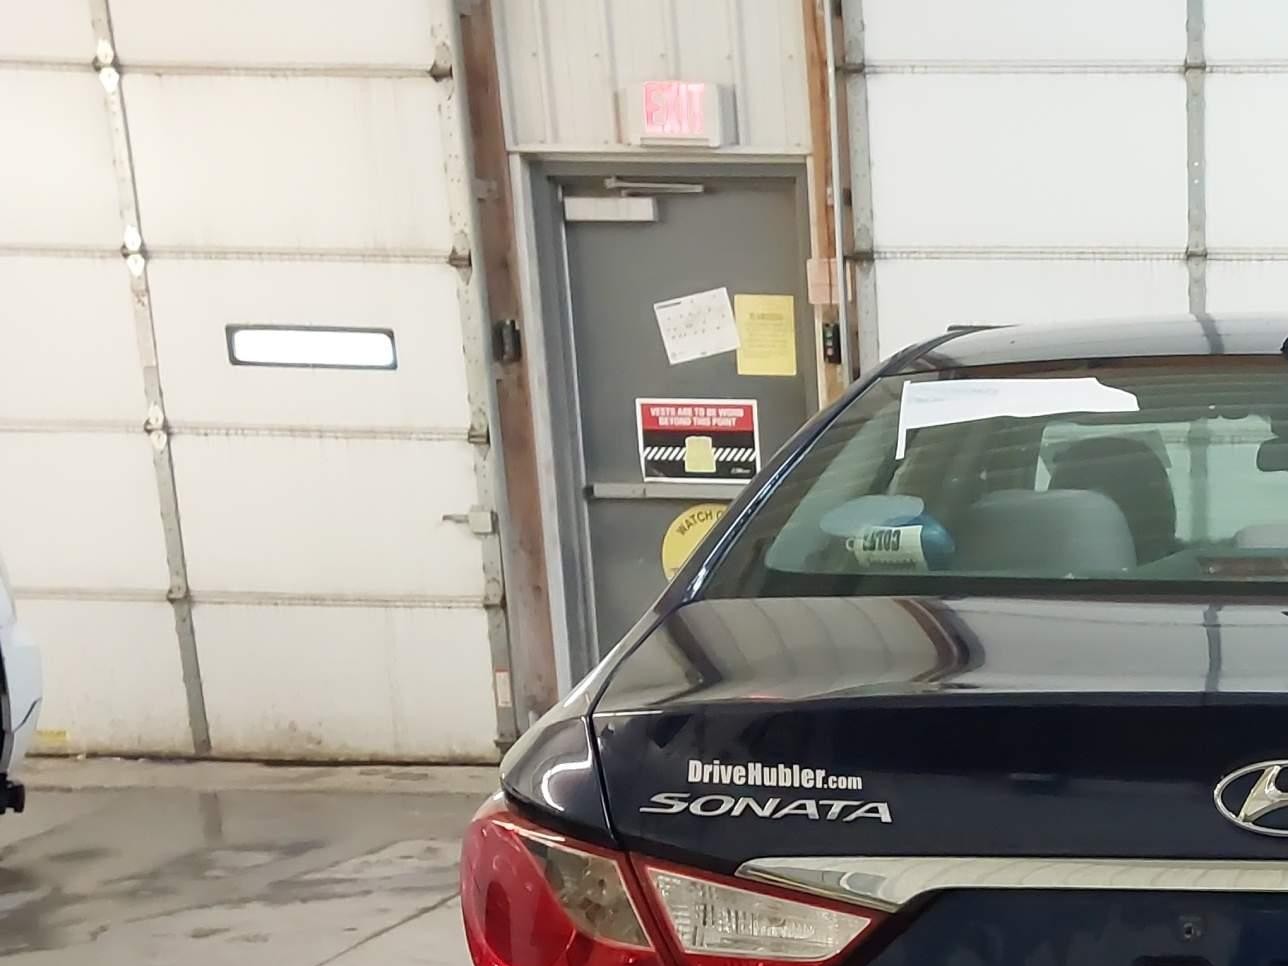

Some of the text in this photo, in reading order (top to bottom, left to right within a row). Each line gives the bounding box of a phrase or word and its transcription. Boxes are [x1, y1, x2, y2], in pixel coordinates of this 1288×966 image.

[645, 82, 705, 134] EXIT
[650, 407, 676, 417] VESTS
[677, 407, 693, 417] ARE
[694, 408, 705, 417] TO
[706, 408, 717, 417] BE
[658, 416, 737, 427] BEYOND THIS POINT
[675, 510, 713, 537] WATCH
[687, 759, 863, 790] DriveHubler.com
[639, 792, 894, 824] SONATA
